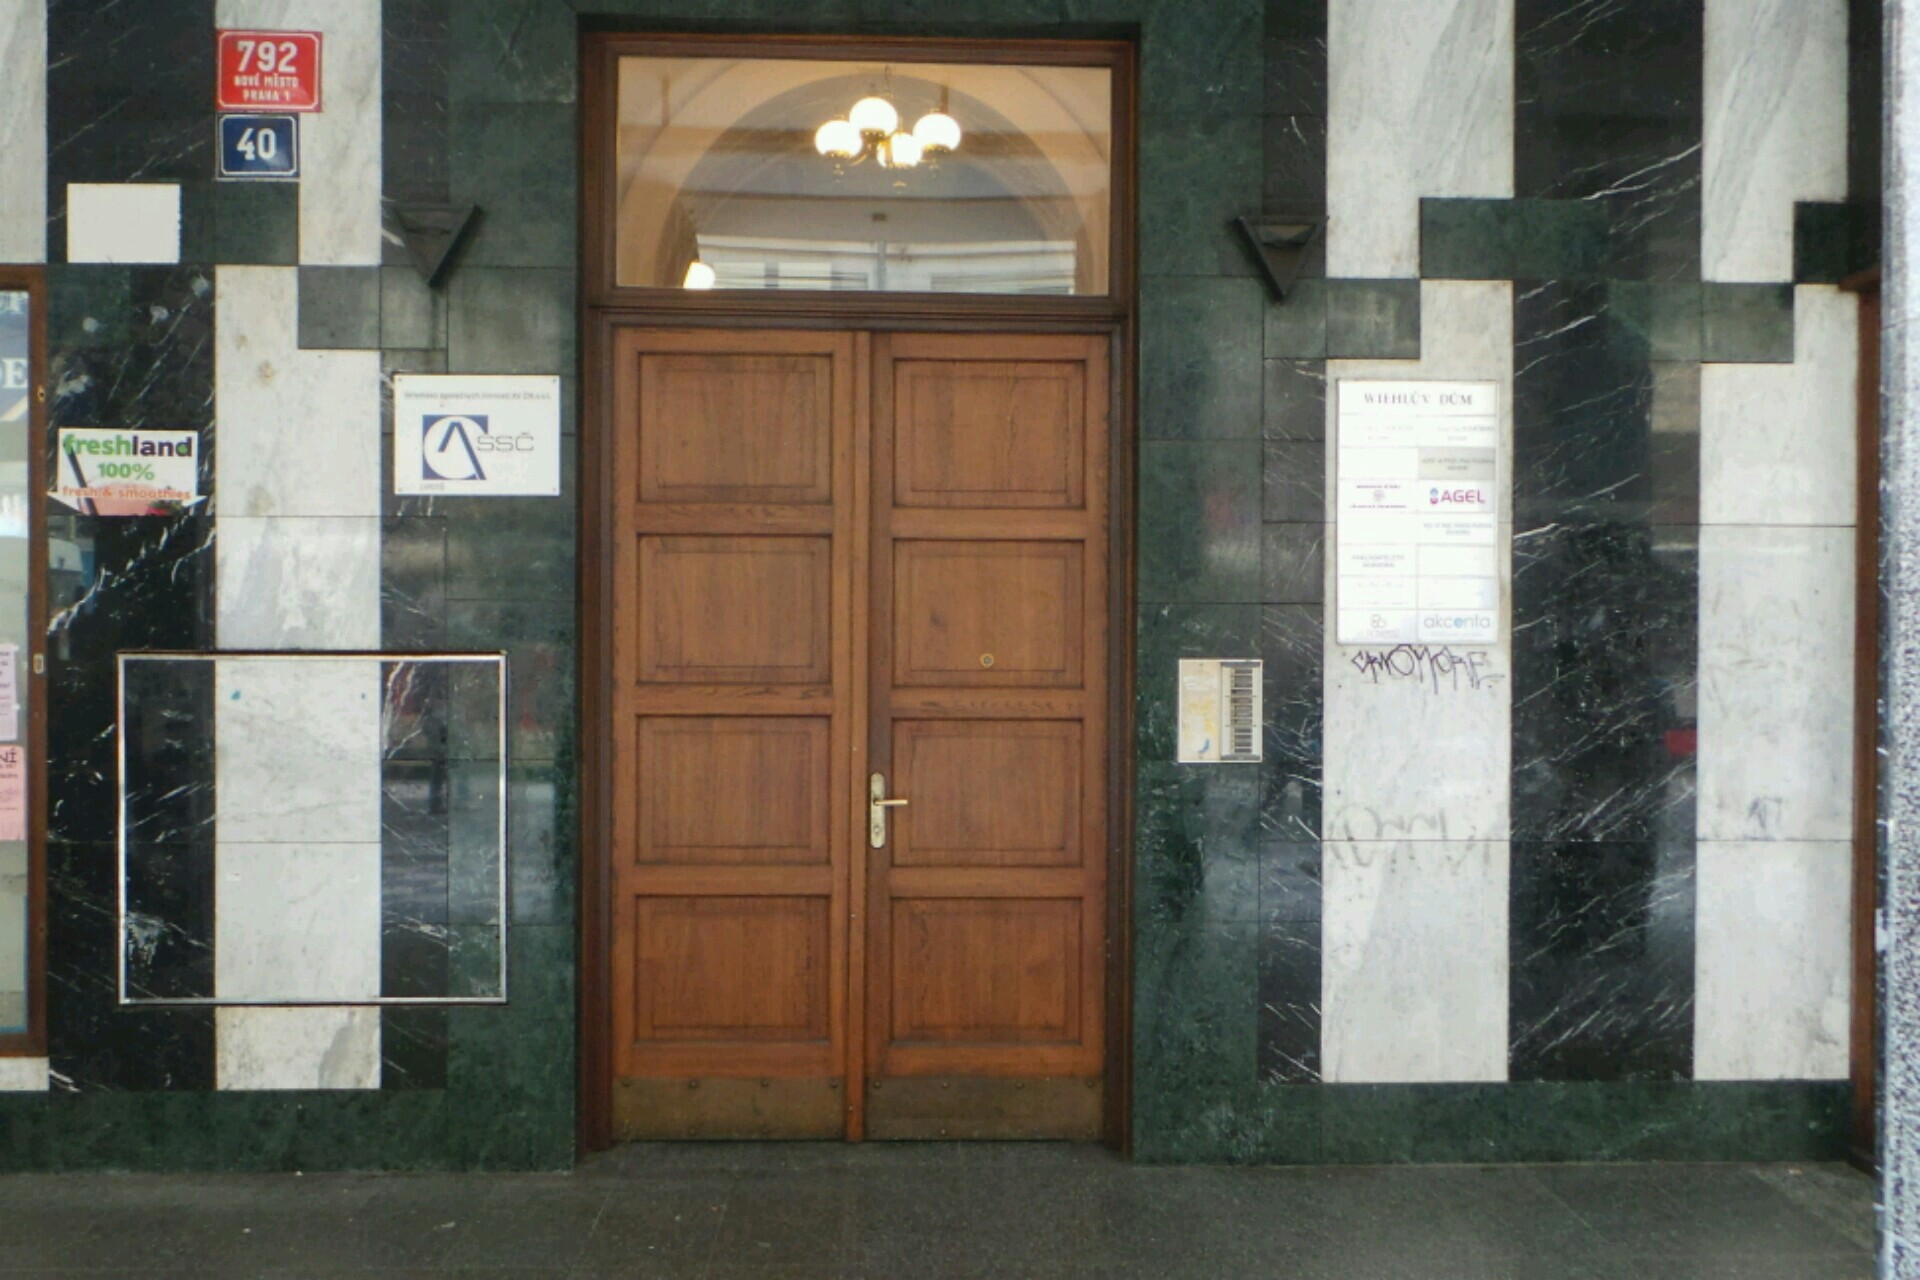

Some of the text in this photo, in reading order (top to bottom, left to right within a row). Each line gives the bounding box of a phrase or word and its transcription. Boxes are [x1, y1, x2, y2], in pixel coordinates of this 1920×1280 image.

[237, 41, 297, 72] 792
[234, 73, 299, 87] NOVÉ MĚSTO
[243, 89, 279, 101] PRAHA
[236, 128, 276, 161] 40
[63, 434, 192, 457] freshland
[97, 463, 155, 480] 100%
[63, 486, 191, 499] fresh & smoothies
[1440, 489, 1486, 504] AGEL
